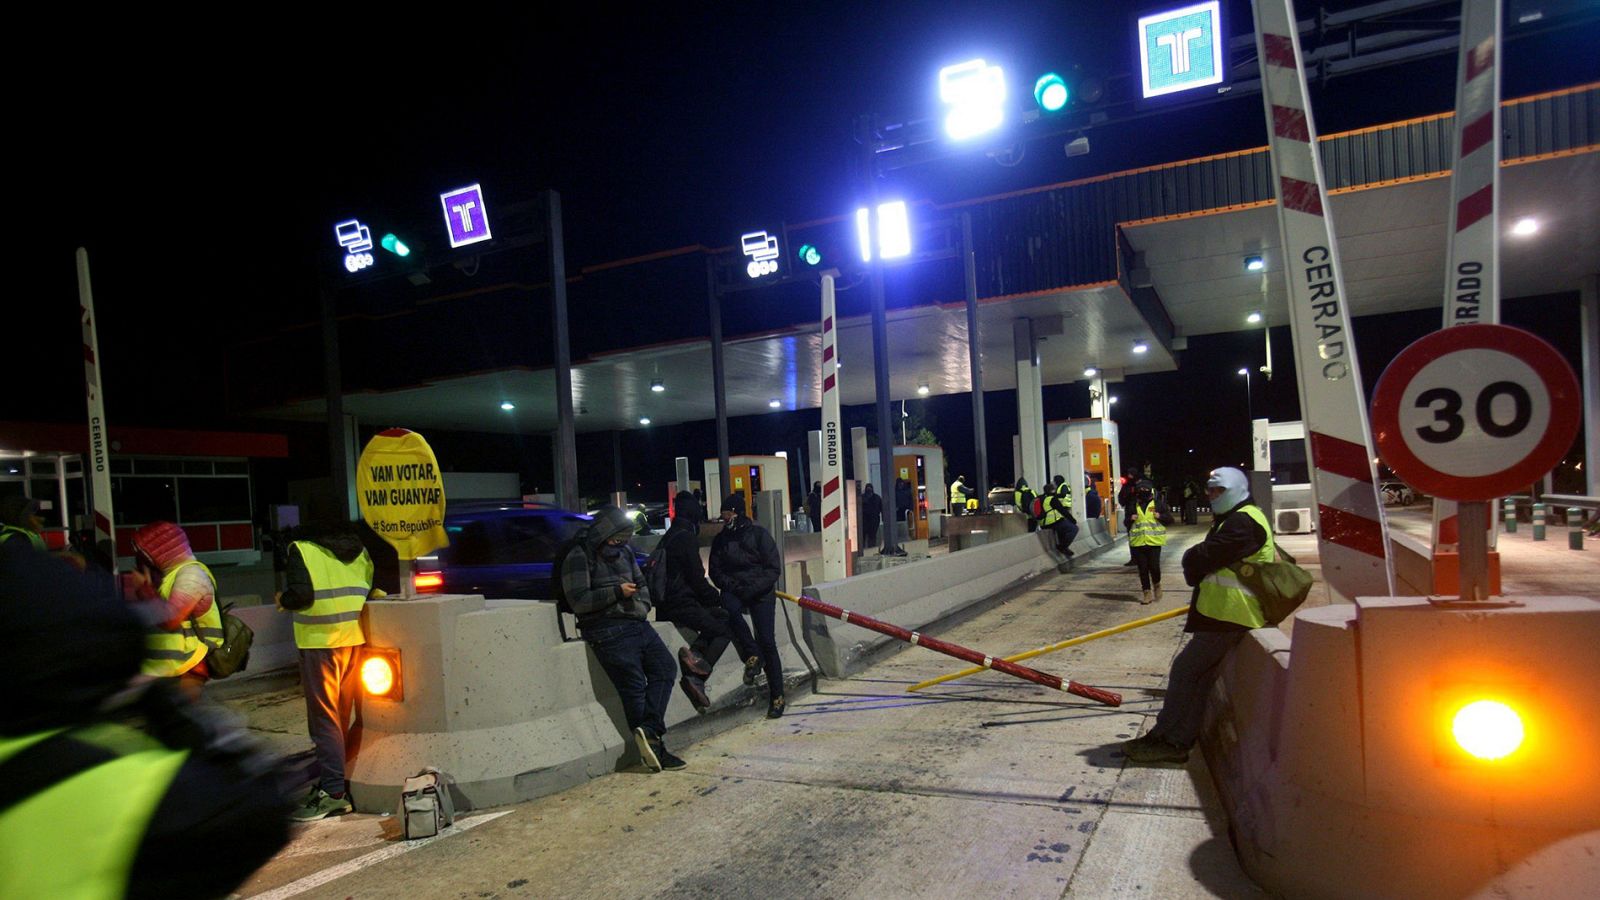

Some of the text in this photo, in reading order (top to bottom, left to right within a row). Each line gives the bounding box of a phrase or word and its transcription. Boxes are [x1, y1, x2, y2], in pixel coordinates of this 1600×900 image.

[1303, 246, 1349, 381] CERRADO
[1455, 261, 1483, 327] RADO
[1414, 380, 1533, 444] 30
[91, 417, 104, 472] CERRADO
[827, 421, 837, 466] CERRADO
[365, 489, 388, 506] VAM
[371, 463, 436, 483] VAM VOTAR,
